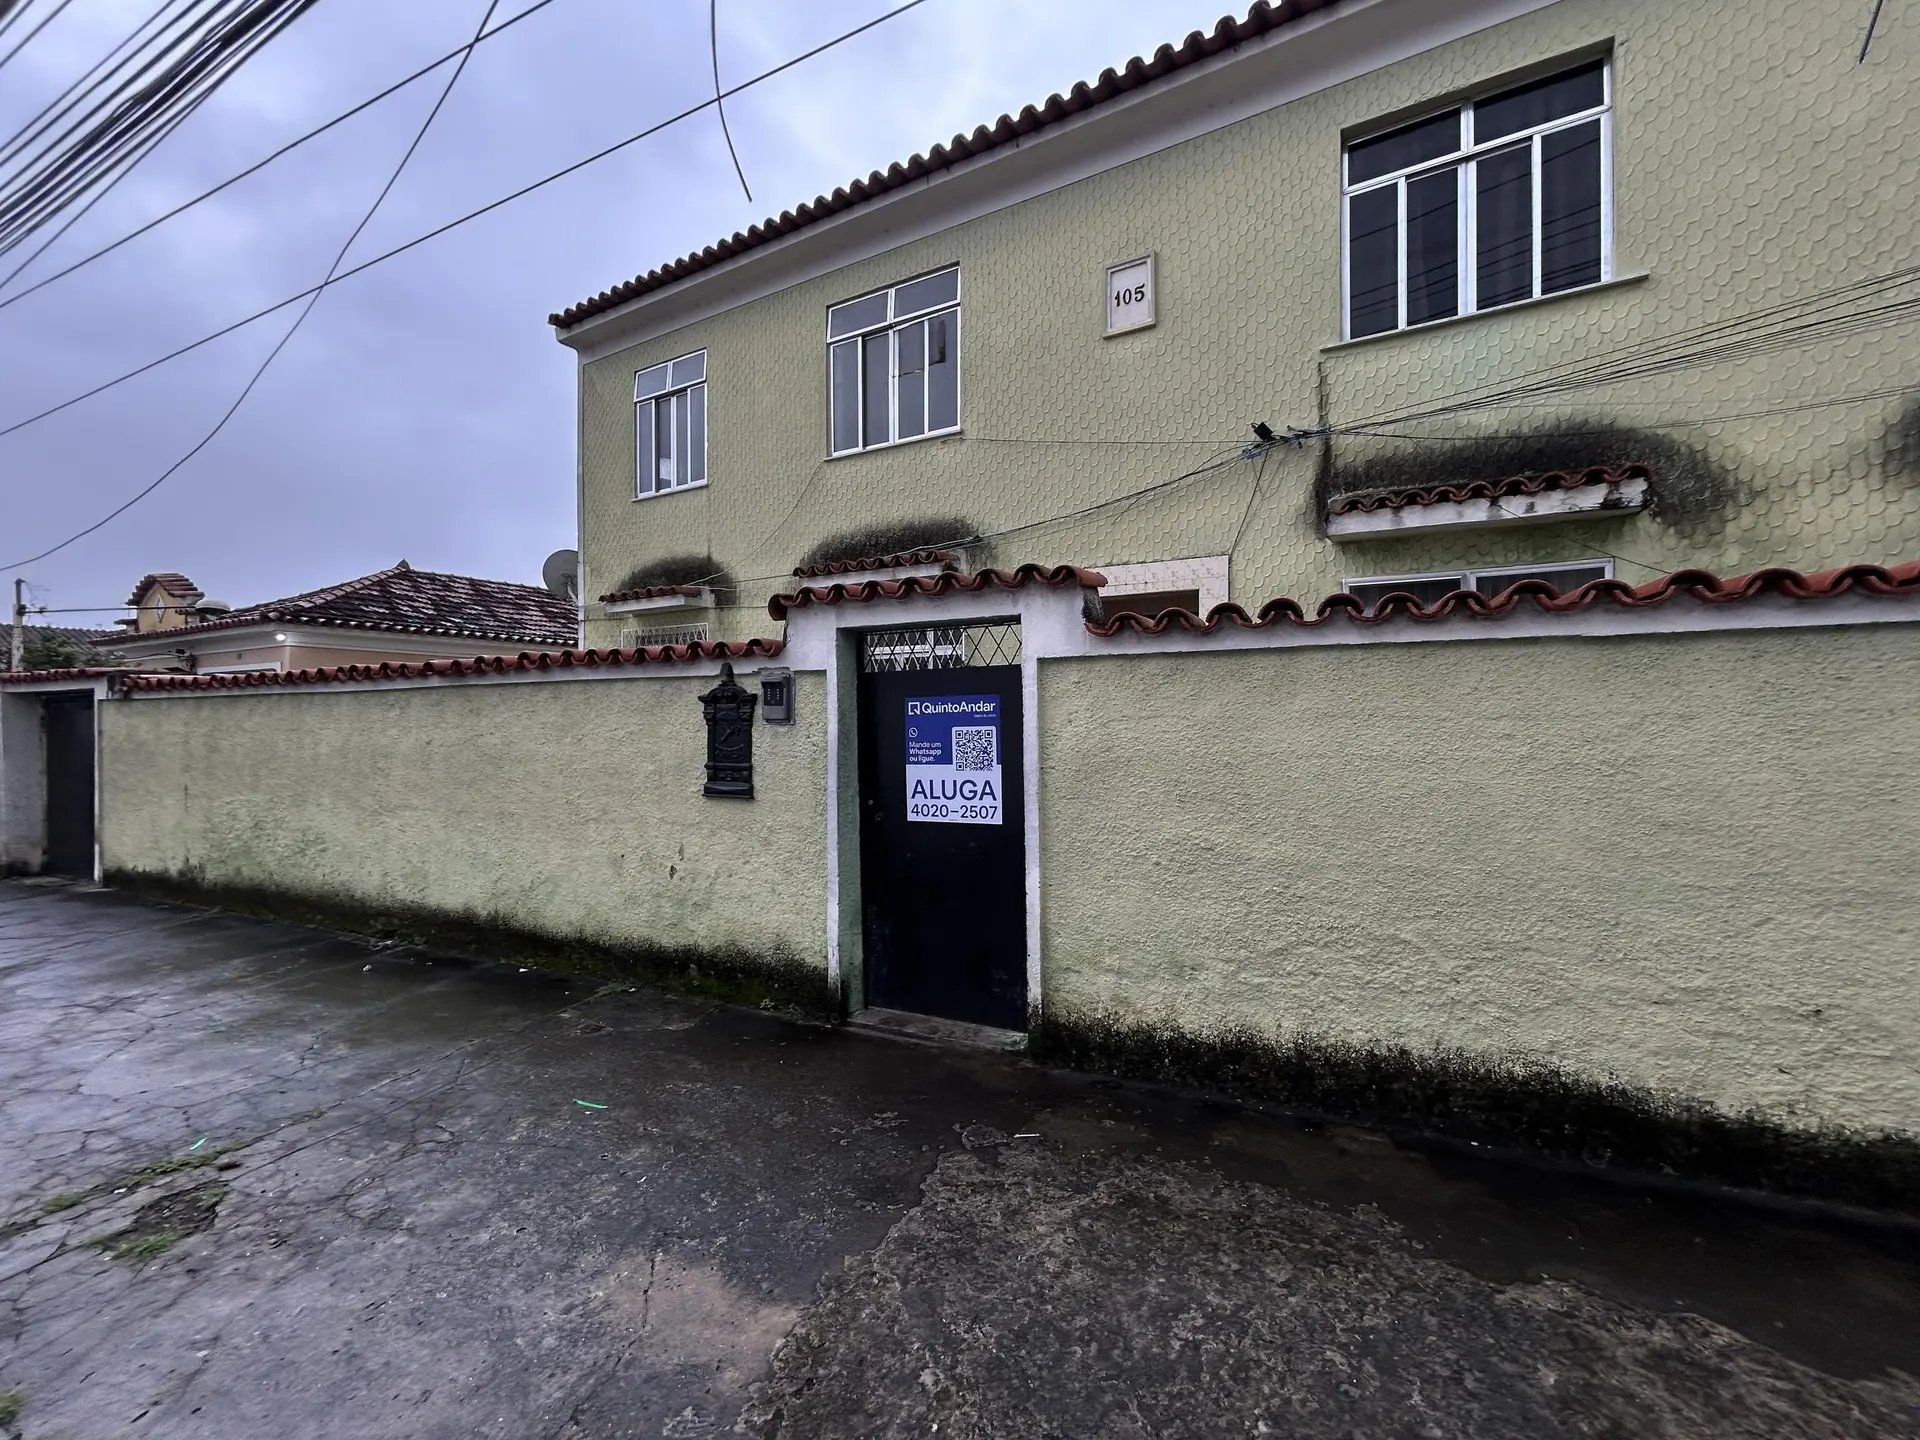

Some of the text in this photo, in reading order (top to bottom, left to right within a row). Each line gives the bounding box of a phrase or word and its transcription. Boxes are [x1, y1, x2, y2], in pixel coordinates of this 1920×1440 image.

[1114, 283, 1145, 307] 105
[922, 701, 996, 714] QuintoAndar
[909, 748, 942, 756] Whatsapp
[910, 779, 997, 801] ALUGA
[911, 804, 998, 819] 4020-2507
